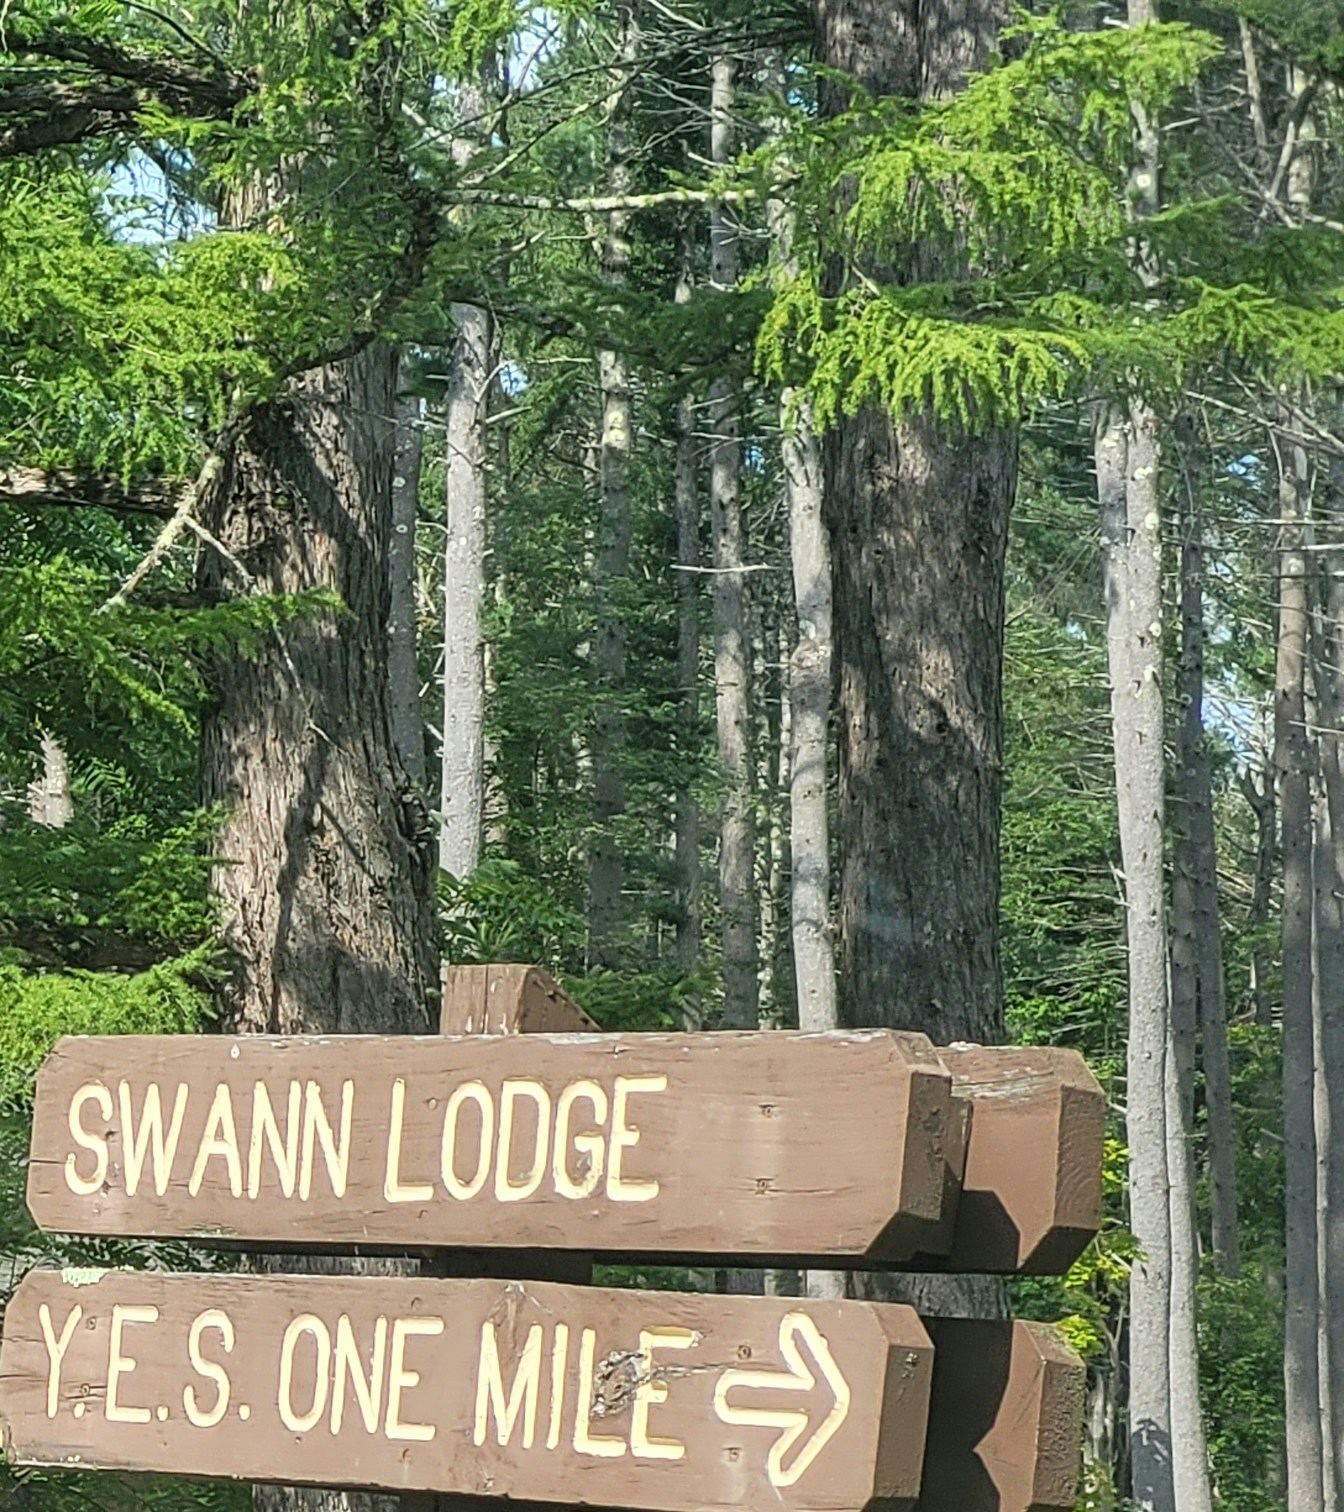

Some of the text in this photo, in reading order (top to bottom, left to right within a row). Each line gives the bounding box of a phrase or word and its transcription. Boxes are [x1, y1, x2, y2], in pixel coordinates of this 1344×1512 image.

[64, 1073, 669, 1203] SWANN LODGE
[37, 1303, 705, 1460] Y.E.S. ONE MILE
